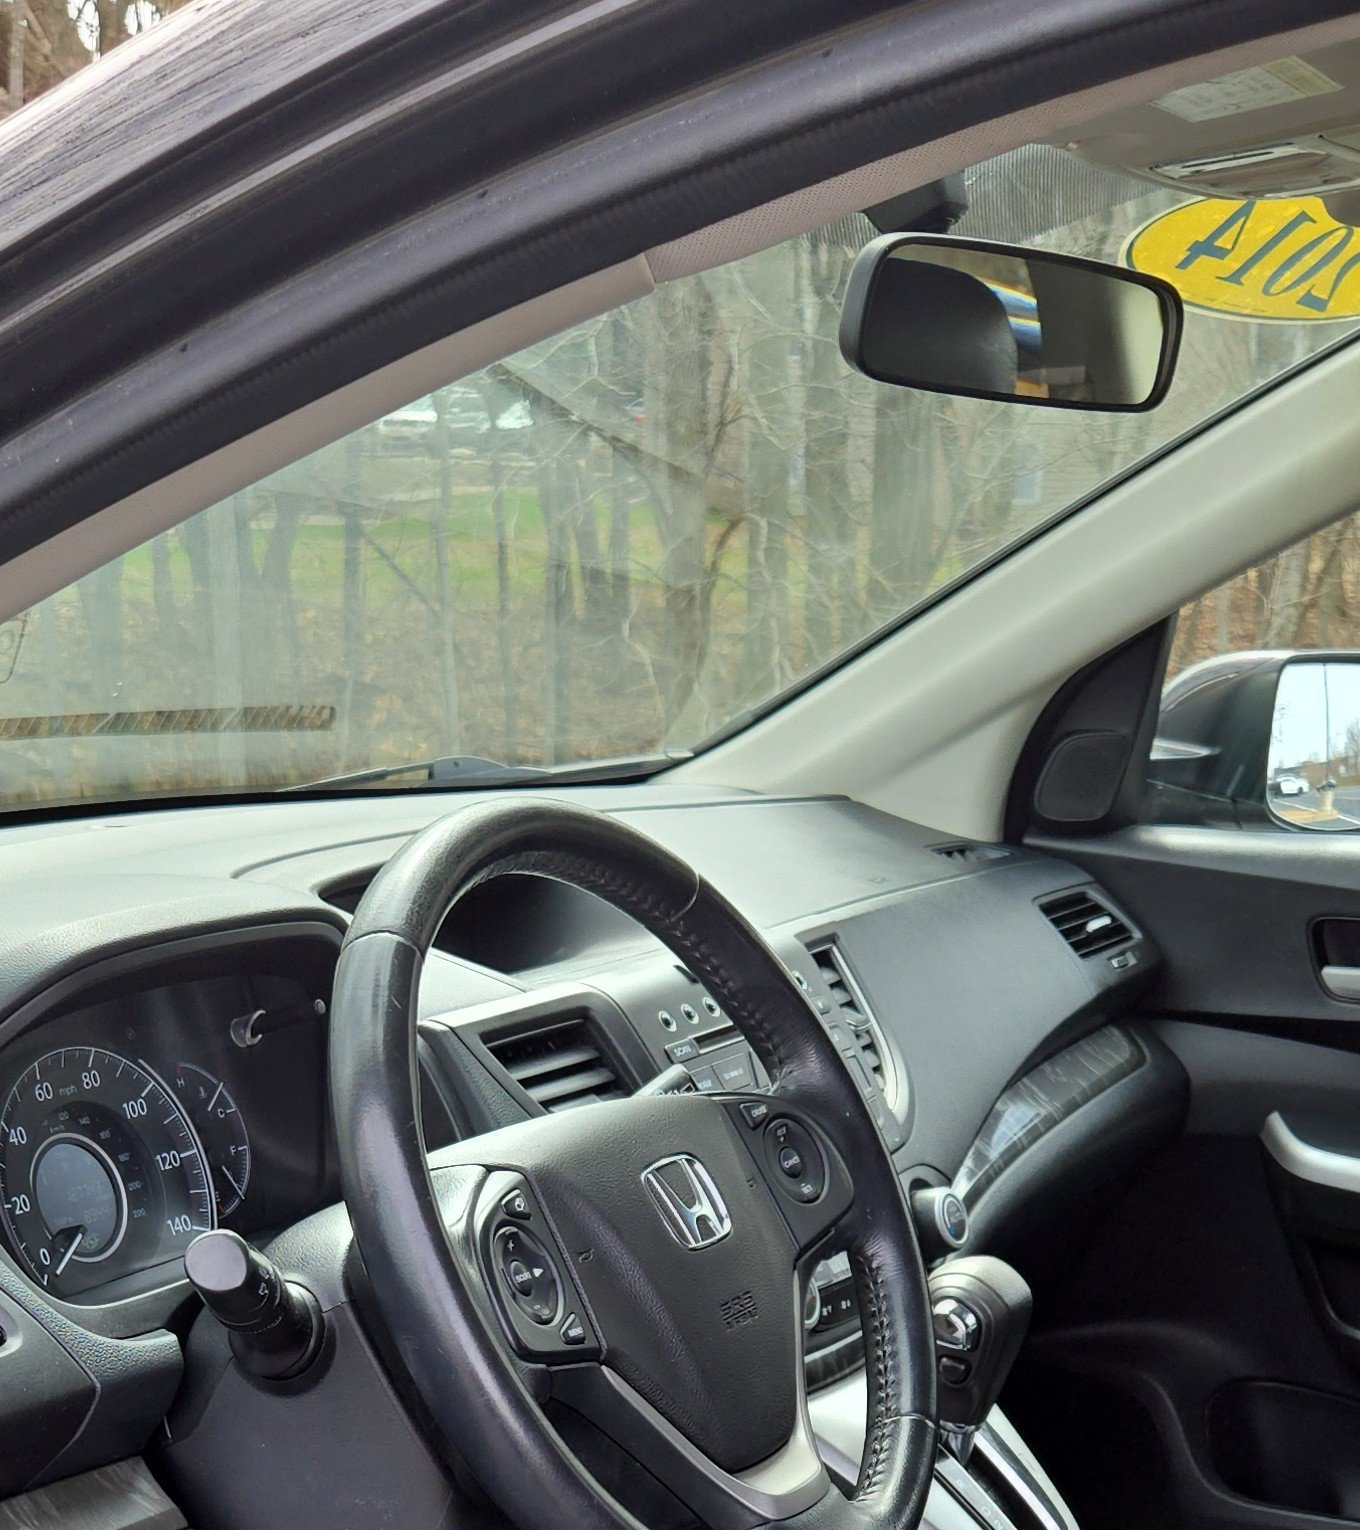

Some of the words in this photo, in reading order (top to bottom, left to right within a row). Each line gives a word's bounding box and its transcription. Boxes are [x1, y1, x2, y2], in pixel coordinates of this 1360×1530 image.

[82, 1070, 100, 1089] 80
[35, 1082, 53, 1101] 60
[60, 1084, 77, 1096] mph
[122, 1099, 147, 1119] 100
[9, 1127, 27, 1145] 40
[155, 1151, 181, 1171] 120
[11, 1194, 30, 1215] 20
[167, 1215, 191, 1235] 140
[40, 1248, 50, 1266] 0
